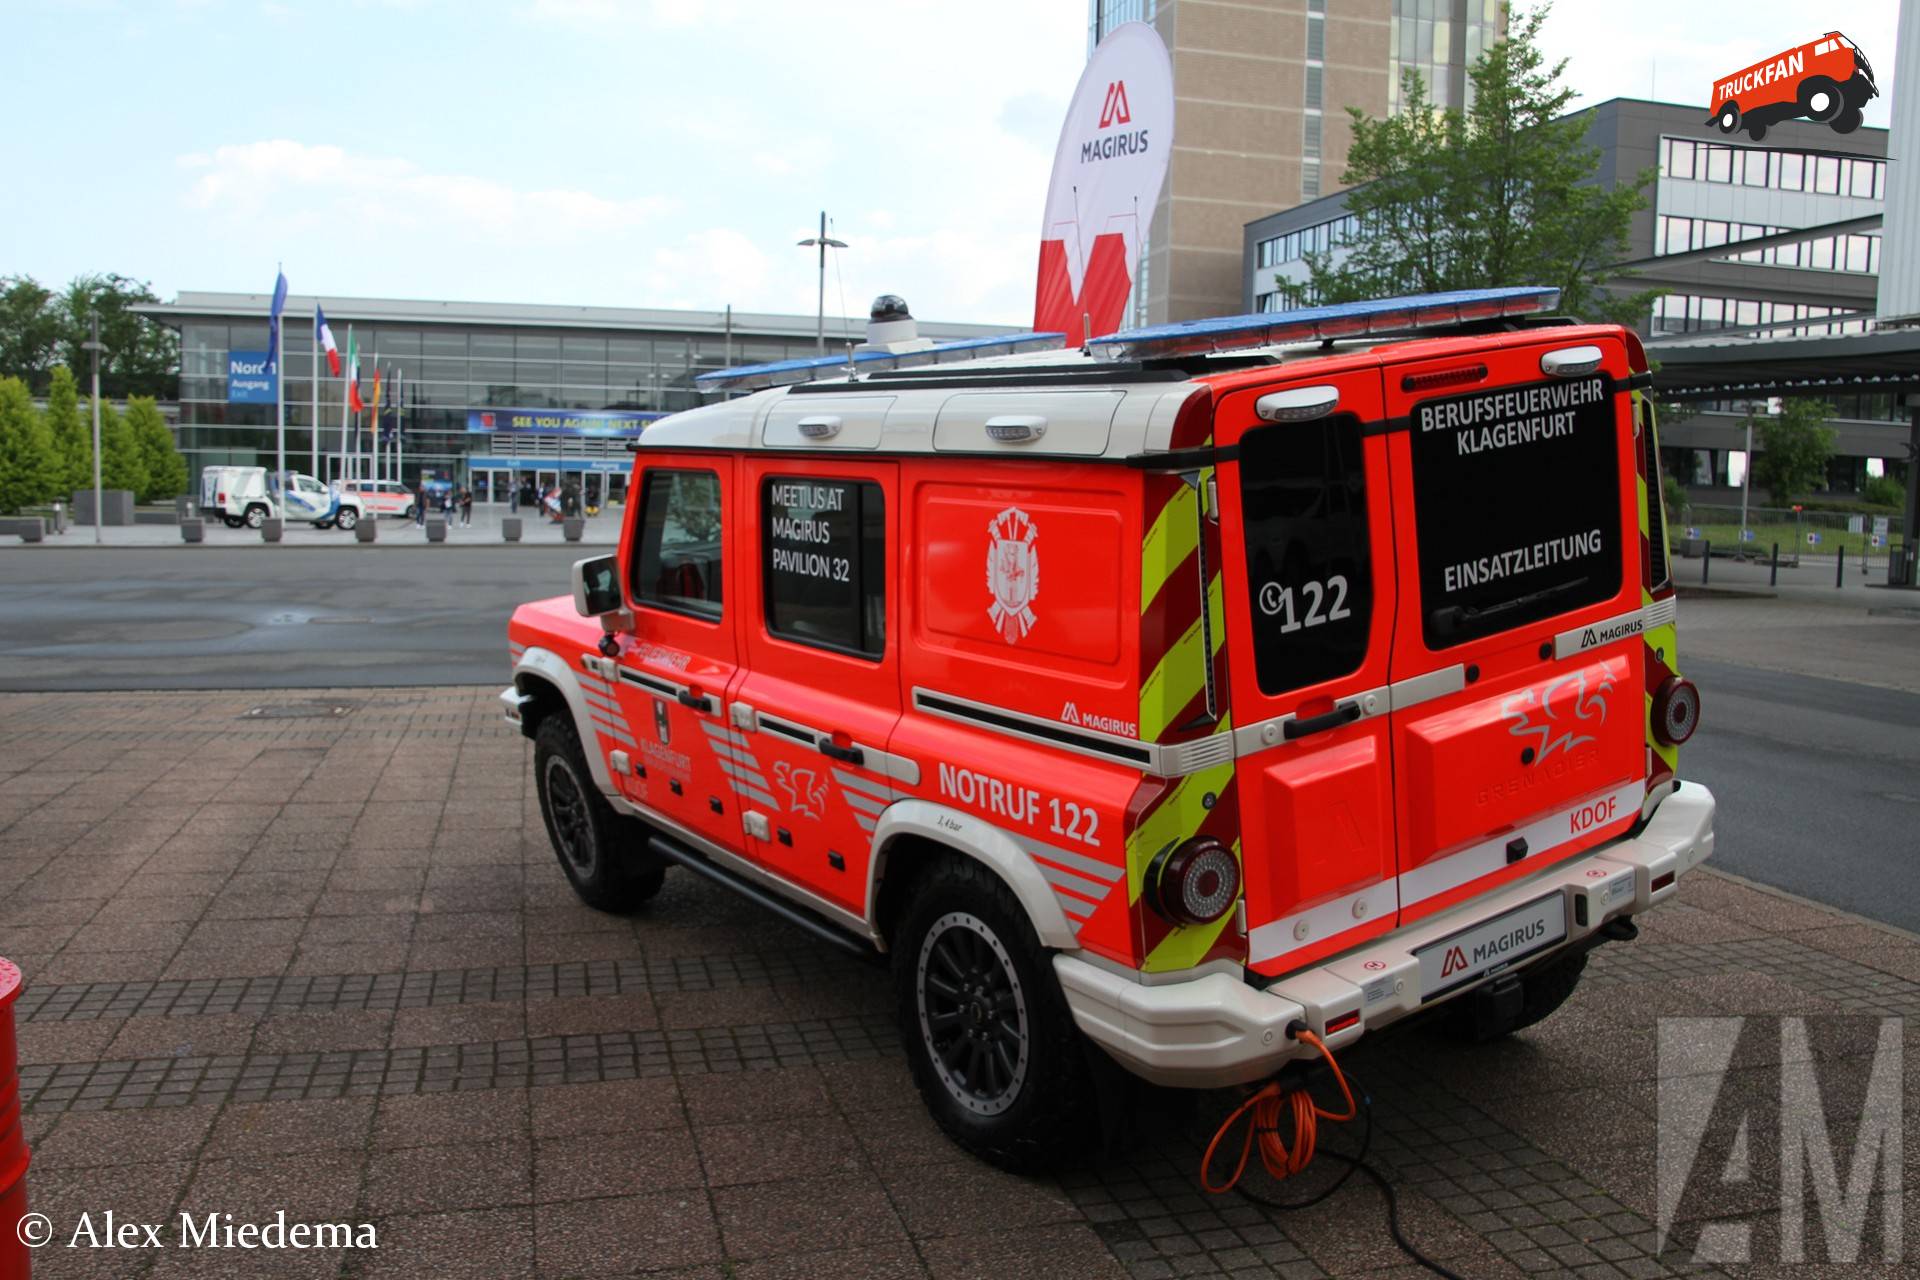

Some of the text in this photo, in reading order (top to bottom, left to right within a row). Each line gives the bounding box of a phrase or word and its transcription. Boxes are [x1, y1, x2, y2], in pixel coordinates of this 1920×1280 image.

[1080, 129, 1149, 164] MAGIRUS
[231, 379, 269, 391] Ausgang
[269, 361, 277, 375] 1
[1420, 379, 1604, 432] BERUFSFEUERWEHR
[512, 416, 533, 428] SEE
[535, 416, 561, 429] YOU
[607, 419, 639, 431] NEXT
[1456, 411, 1576, 456] KLAGENFURT
[771, 484, 845, 512] MEET US AT
[772, 516, 831, 545] MAGIRUS
[772, 548, 850, 583] PAVILION 32
[1443, 528, 1602, 592] EINSATZLEITUNG
[1278, 574, 1352, 634] 122
[1599, 620, 1644, 643] MAGIRUS
[1082, 712, 1137, 737] MAGIRUS
[938, 762, 1101, 847] NOTRUF 122
[1569, 796, 1617, 835] KDOF
[1473, 919, 1545, 964] MAGIRUS
